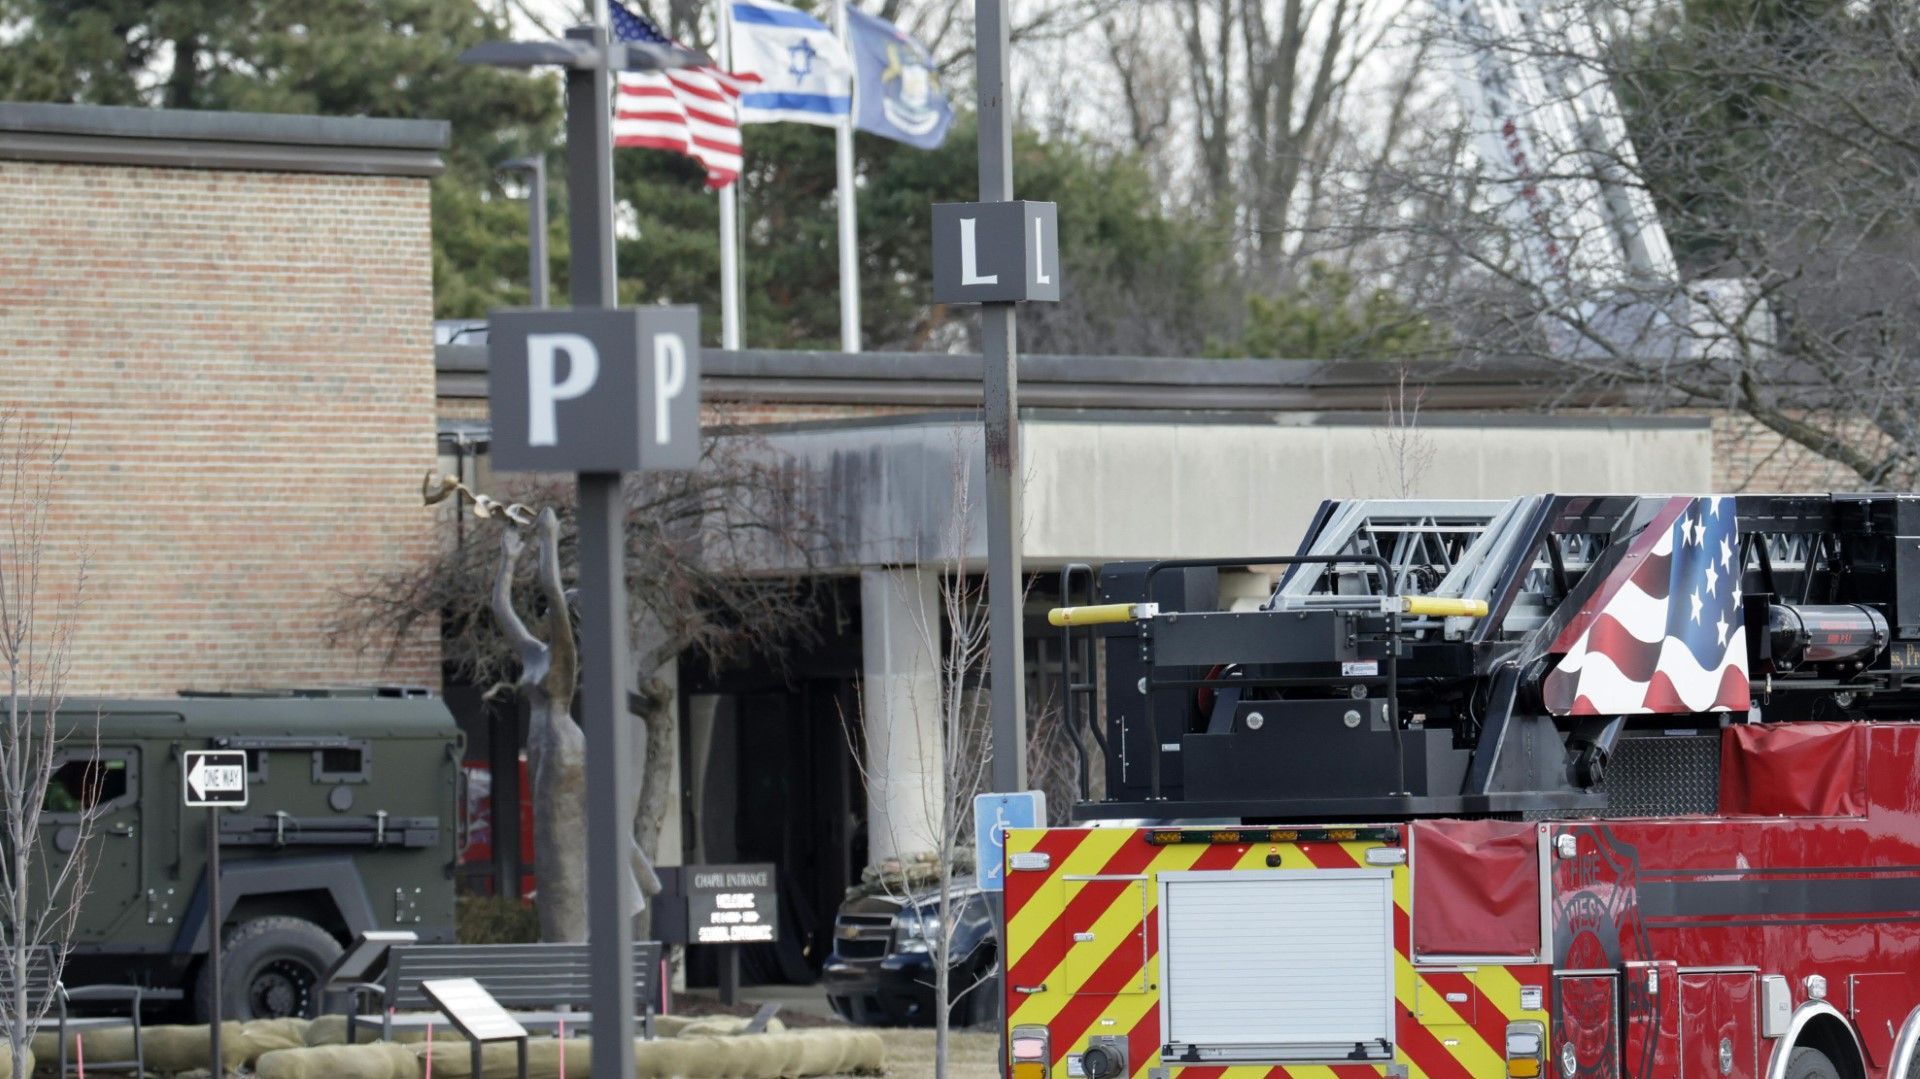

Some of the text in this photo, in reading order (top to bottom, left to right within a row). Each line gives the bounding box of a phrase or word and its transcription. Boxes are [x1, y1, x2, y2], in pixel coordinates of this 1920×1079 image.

[960, 216, 998, 286] L
[1034, 216, 1050, 285] L
[526, 332, 600, 447] P
[653, 331, 687, 446] P
[204, 769, 239, 787] ONE WAY
[694, 871, 768, 888] CHAPEL ENTRANCE
[1569, 854, 1601, 885] FIRE
[1566, 898, 1605, 934] WEST
